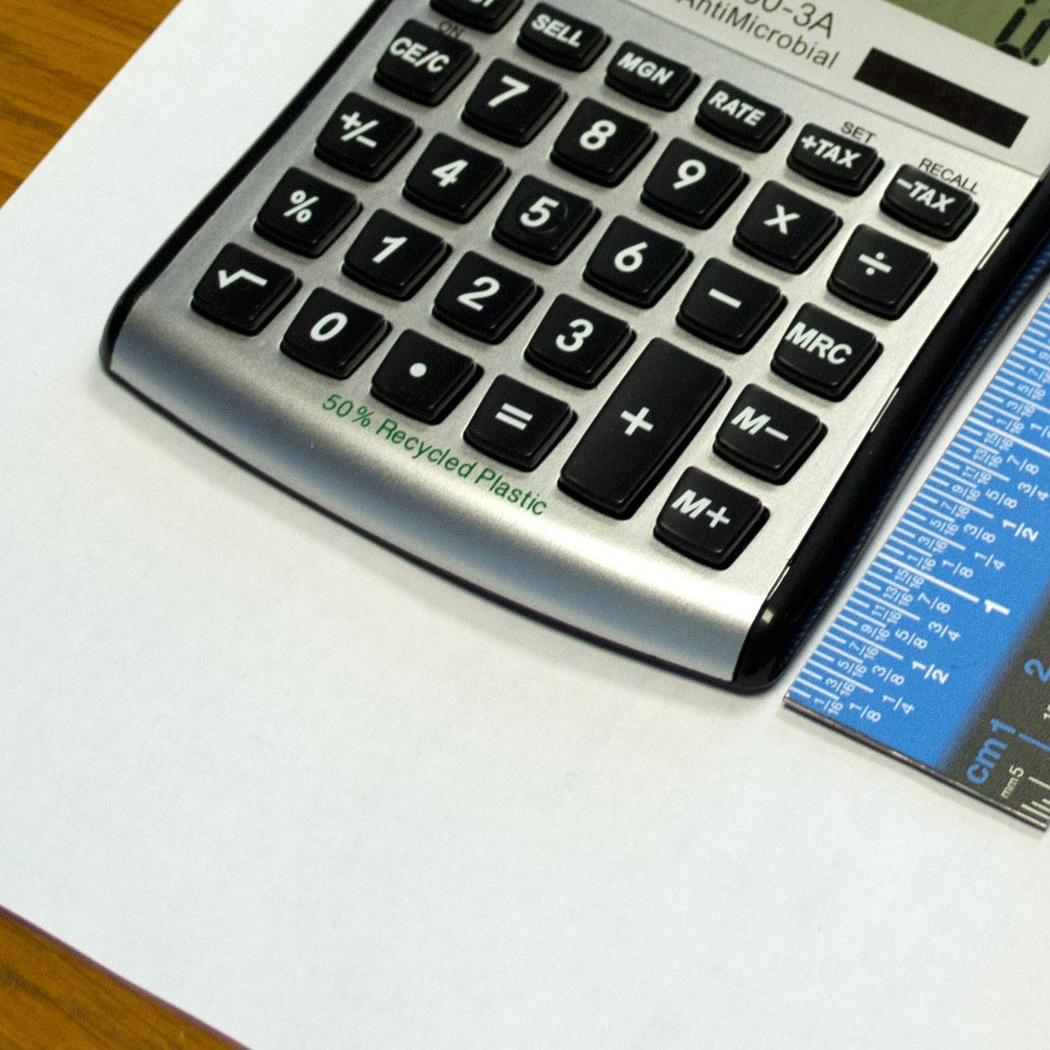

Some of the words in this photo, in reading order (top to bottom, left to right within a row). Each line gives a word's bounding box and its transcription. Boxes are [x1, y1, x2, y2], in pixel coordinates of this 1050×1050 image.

[439, 21, 464, 39] ON
[530, 14, 585, 48] SELL
[389, 37, 451, 73] CE/C
[618, 51, 674, 86] MGN
[487, 76, 529, 108] 7
[708, 90, 766, 126] RATE
[579, 120, 617, 151] 8
[842, 121, 876, 144] SET
[801, 134, 861, 169] +TAX
[431, 159, 469, 188] 4
[673, 158, 706, 190] 9
[919, 158, 980, 194] RECALL
[283, 190, 319, 223] %
[520, 196, 559, 228] 5
[372, 235, 408, 263] 1
[614, 241, 648, 273] 6
[458, 276, 501, 311] 2
[555, 319, 594, 352] 3
[784, 322, 852, 365] MRC
[375, 418, 476, 479] Recycled
[475, 468, 548, 516] Plastic
[672, 489, 731, 528] M+
[984, 598, 1011, 616] 1
